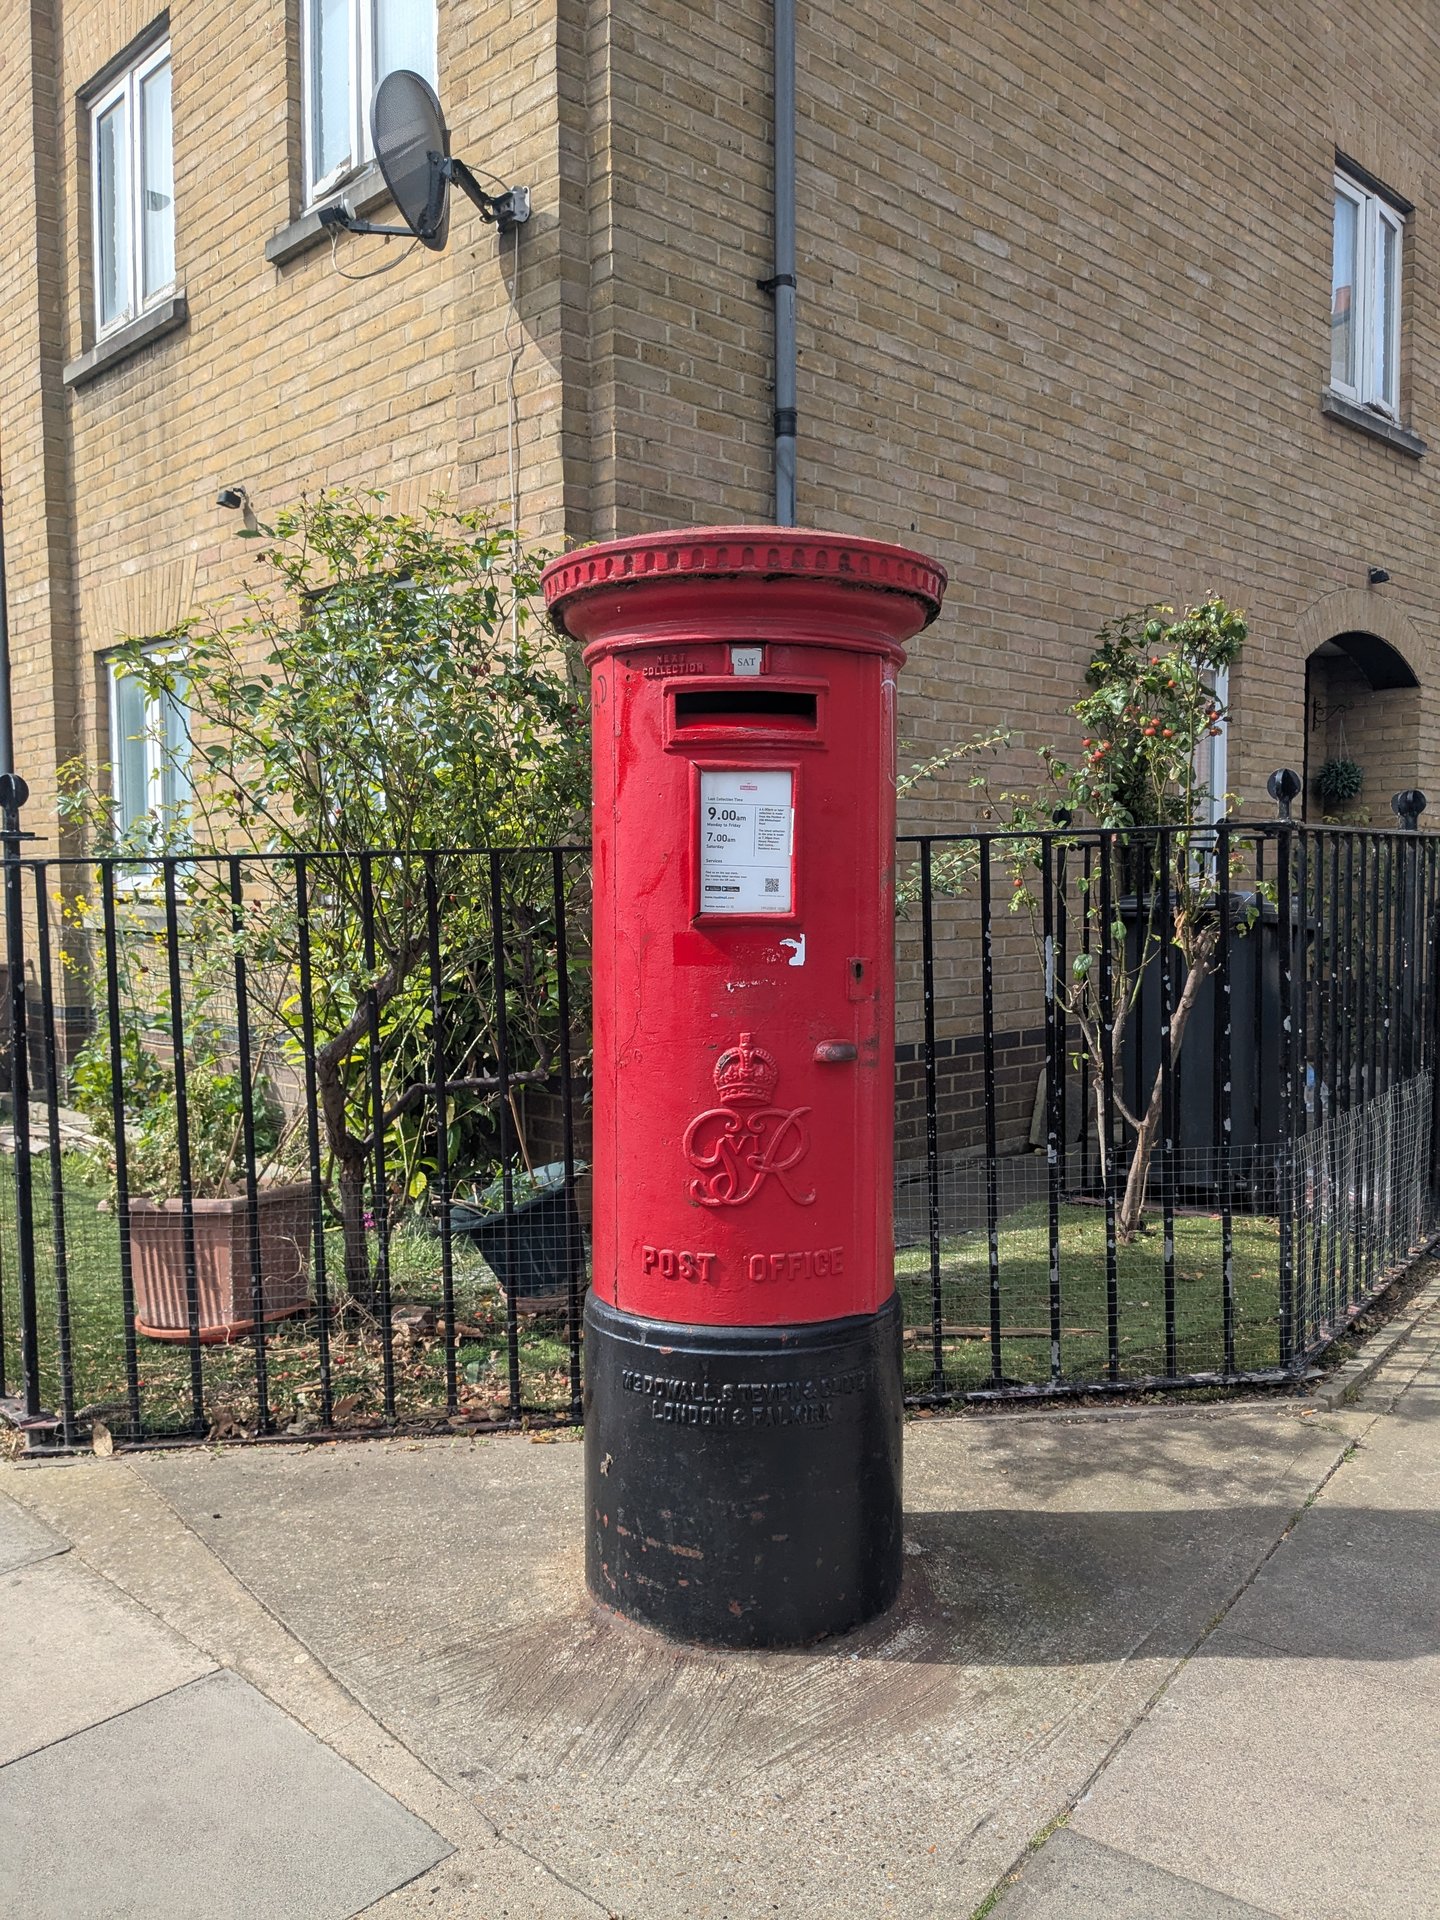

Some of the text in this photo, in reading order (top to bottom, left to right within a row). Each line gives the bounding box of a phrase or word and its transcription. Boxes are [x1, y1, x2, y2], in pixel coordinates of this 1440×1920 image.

[656, 653, 686, 664] NEXT
[737, 657, 756, 667] SAT
[642, 663, 705, 677] COLLECTION
[642, 1245, 844, 1281] POST OFFICE
[651, 1399, 727, 1425] LONDON
[751, 1403, 833, 1426] FALKIRK
